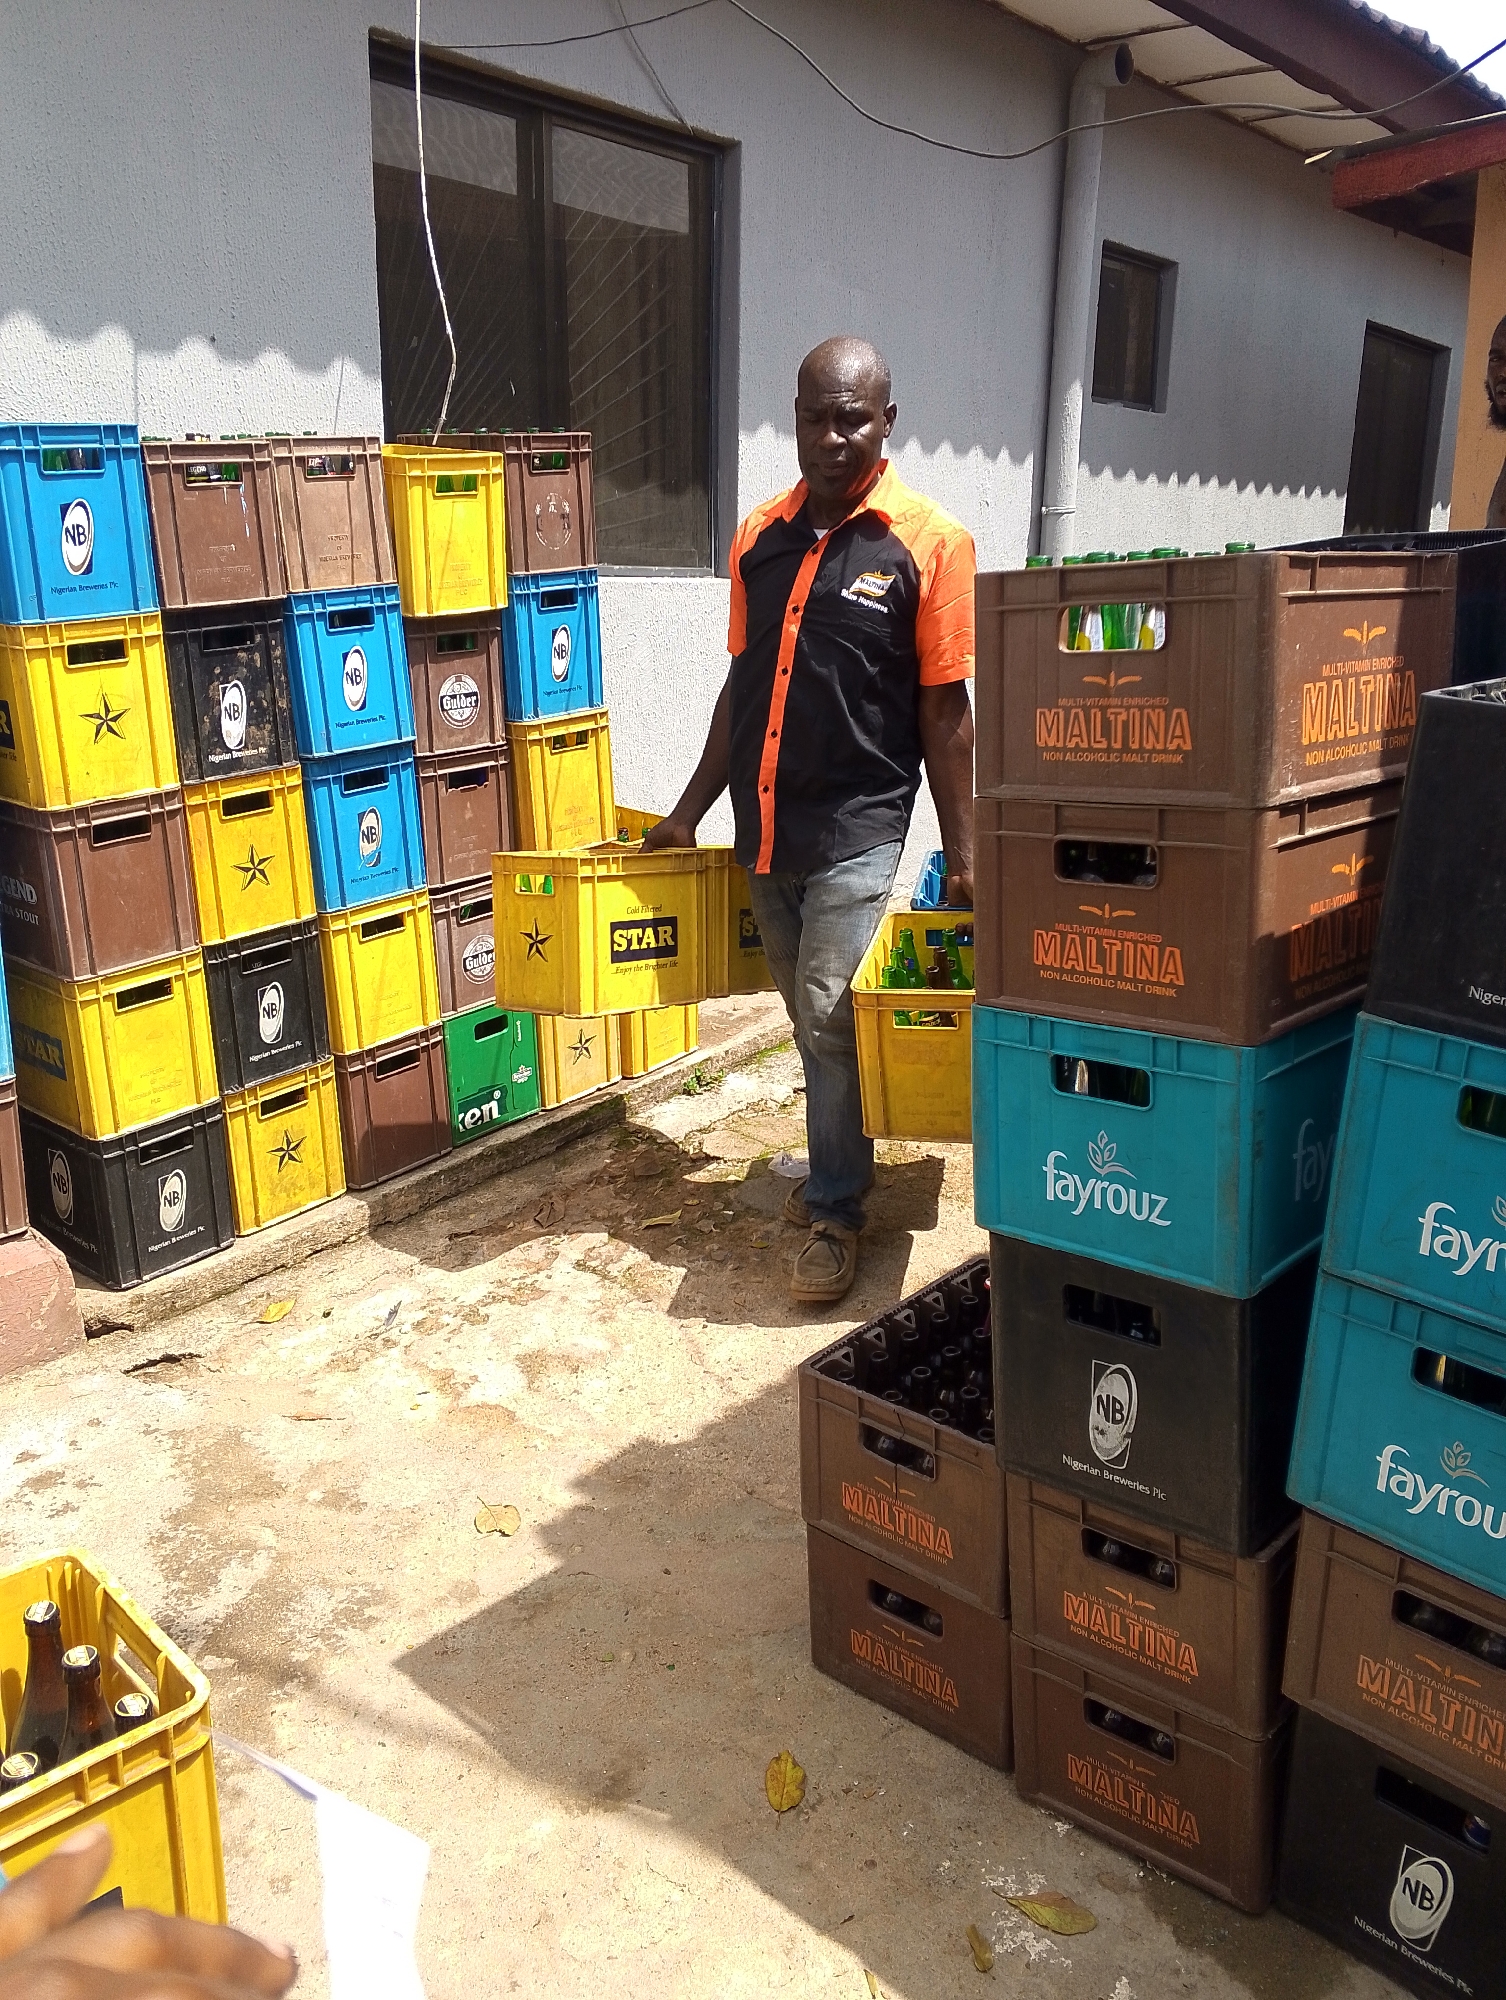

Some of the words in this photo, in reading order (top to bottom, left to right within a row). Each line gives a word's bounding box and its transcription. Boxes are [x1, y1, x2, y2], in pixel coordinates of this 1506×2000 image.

[65, 523, 87, 546] NB
[50, 586, 77, 595] Nigerian
[554, 643, 566, 660] NB
[345, 668, 362, 686] NB
[1322, 658, 1371, 677] MULTI-VITAMIN
[1372, 655, 1404, 672] ENRICHED
[224, 702, 240, 722] NB
[442, 694, 476, 710] Gulder
[1058, 697, 1122, 706] MULTI-VITAMIN
[1122, 697, 1170, 706] ENRICHED
[1302, 670, 1417, 746] MALTINA
[1036, 708, 1192, 750] MALTINA
[1043, 752, 1064, 761] NON
[1065, 752, 1120, 762] ALCOHOLIC
[1122, 753, 1150, 763] MALT
[1152, 753, 1184, 764] DRINK
[1305, 752, 1324, 766] NON
[1326, 741, 1367, 762] ALCOHOLIC
[1368, 738, 1388, 753] MALT
[361, 825, 377, 844] NB
[626, 906, 640, 914] Cold
[1310, 890, 1358, 915] MULTI-VITAMIN
[15, 908, 39, 926] STOUT
[613, 926, 675, 952] STAR
[1054, 922, 1116, 938] MULTI-VITAMIN
[1117, 928, 1162, 942] ENRICHED
[1034, 929, 1185, 986] MALTINA
[1040, 970, 1060, 980] NON
[1062, 973, 1115, 988] ALCOHOLIC
[1117, 981, 1144, 992] MALT
[1145, 984, 1177, 997] DRINK
[262, 1002, 278, 1020] NB
[249, 1050, 270, 1062] Nigerian
[52, 1172, 68, 1194] NB
[1042, 1150, 1172, 1226] fayrouz
[164, 1190, 180, 1208] NB
[148, 1239, 171, 1252] Nigerian
[172, 1229, 197, 1244] Breweries
[1096, 1393, 1124, 1426] NB
[1062, 1453, 1101, 1478] Nigerian
[1104, 1469, 1150, 1496] Breweries
[1152, 1486, 1167, 1501] Plc
[842, 1481, 954, 1560] MALTINA
[848, 1514, 864, 1526] NON
[864, 1520, 904, 1544] ALCOHOLIC
[904, 1540, 924, 1554] MALT
[925, 1550, 948, 1566] DRINK
[1083, 1591, 1138, 1620] MULTI-VITAMIN
[1139, 1615, 1180, 1638] ENRICHED
[1064, 1590, 1199, 1677] MALTINA
[1070, 1624, 1088, 1638] NON
[1089, 1633, 1138, 1660] ALCOHOLIC
[1139, 1655, 1162, 1672] MALT
[1164, 1666, 1192, 1685] DRINK
[850, 1628, 959, 1708] MALTINA
[1385, 1656, 1456, 1697] MULTI-VITAMIN
[932, 1698, 955, 1714] DRINK
[1357, 1654, 1506, 1757] MALTIN
[1362, 1692, 1386, 1710] NON
[1388, 1705, 1450, 1742] ALCOHOLIC
[1452, 1737, 1483, 1758] MALT
[1068, 1753, 1200, 1844] MALTINA
[1075, 1786, 1093, 1800] NON
[1094, 1796, 1140, 1824] ALCOHOLIC
[1142, 1819, 1164, 1834] MALT
[1166, 1832, 1193, 1850] DRINK
[1402, 1877, 1434, 1912] NB
[1354, 1915, 1398, 1950] Nigerian
[1400, 1944, 1454, 1984] Breweries
[1456, 1978, 1475, 1997] Plc
